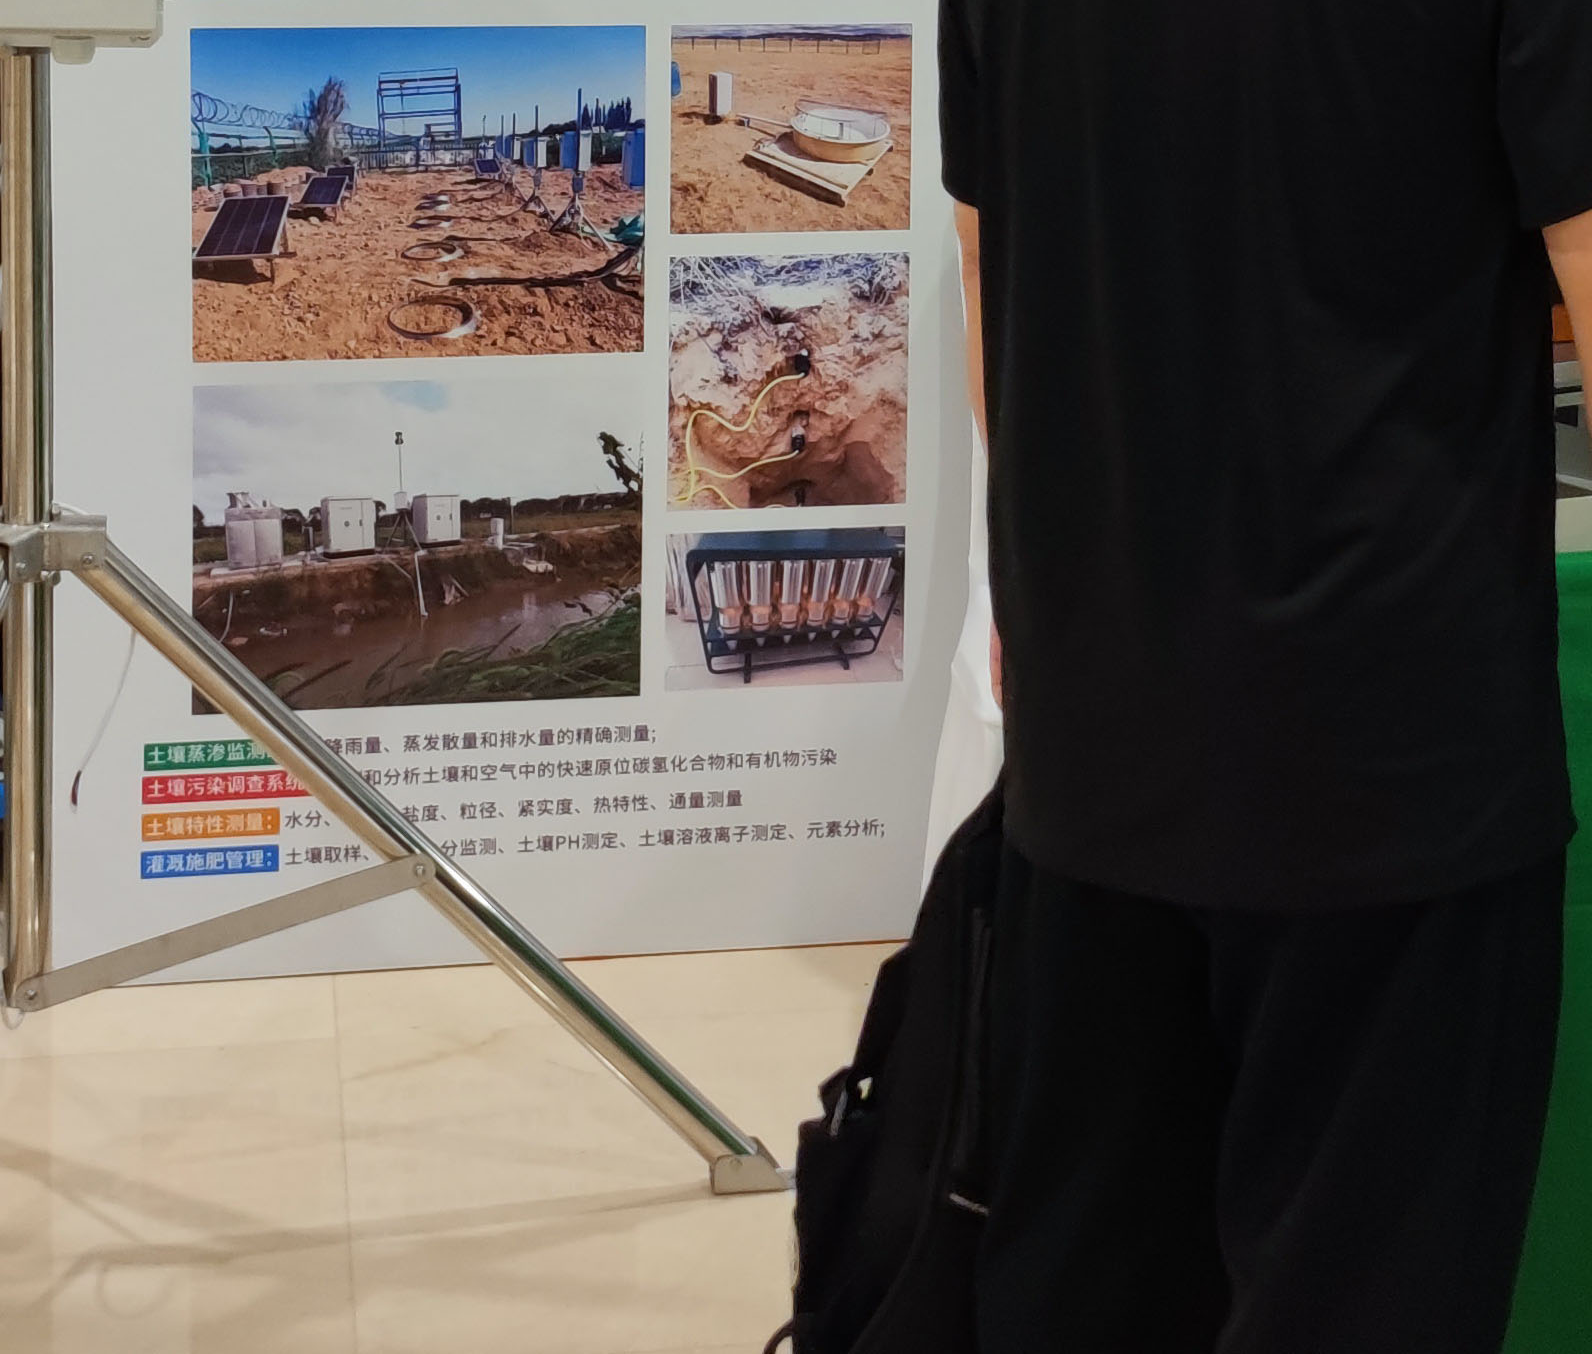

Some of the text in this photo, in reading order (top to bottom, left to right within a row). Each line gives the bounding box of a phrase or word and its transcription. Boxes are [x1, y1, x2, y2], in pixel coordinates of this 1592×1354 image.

[147, 740, 274, 765] 土壤蒸渗监测
[360, 748, 837, 785] 和分析土壤和空气中的快速原位碳氢化合物和有机物污染
